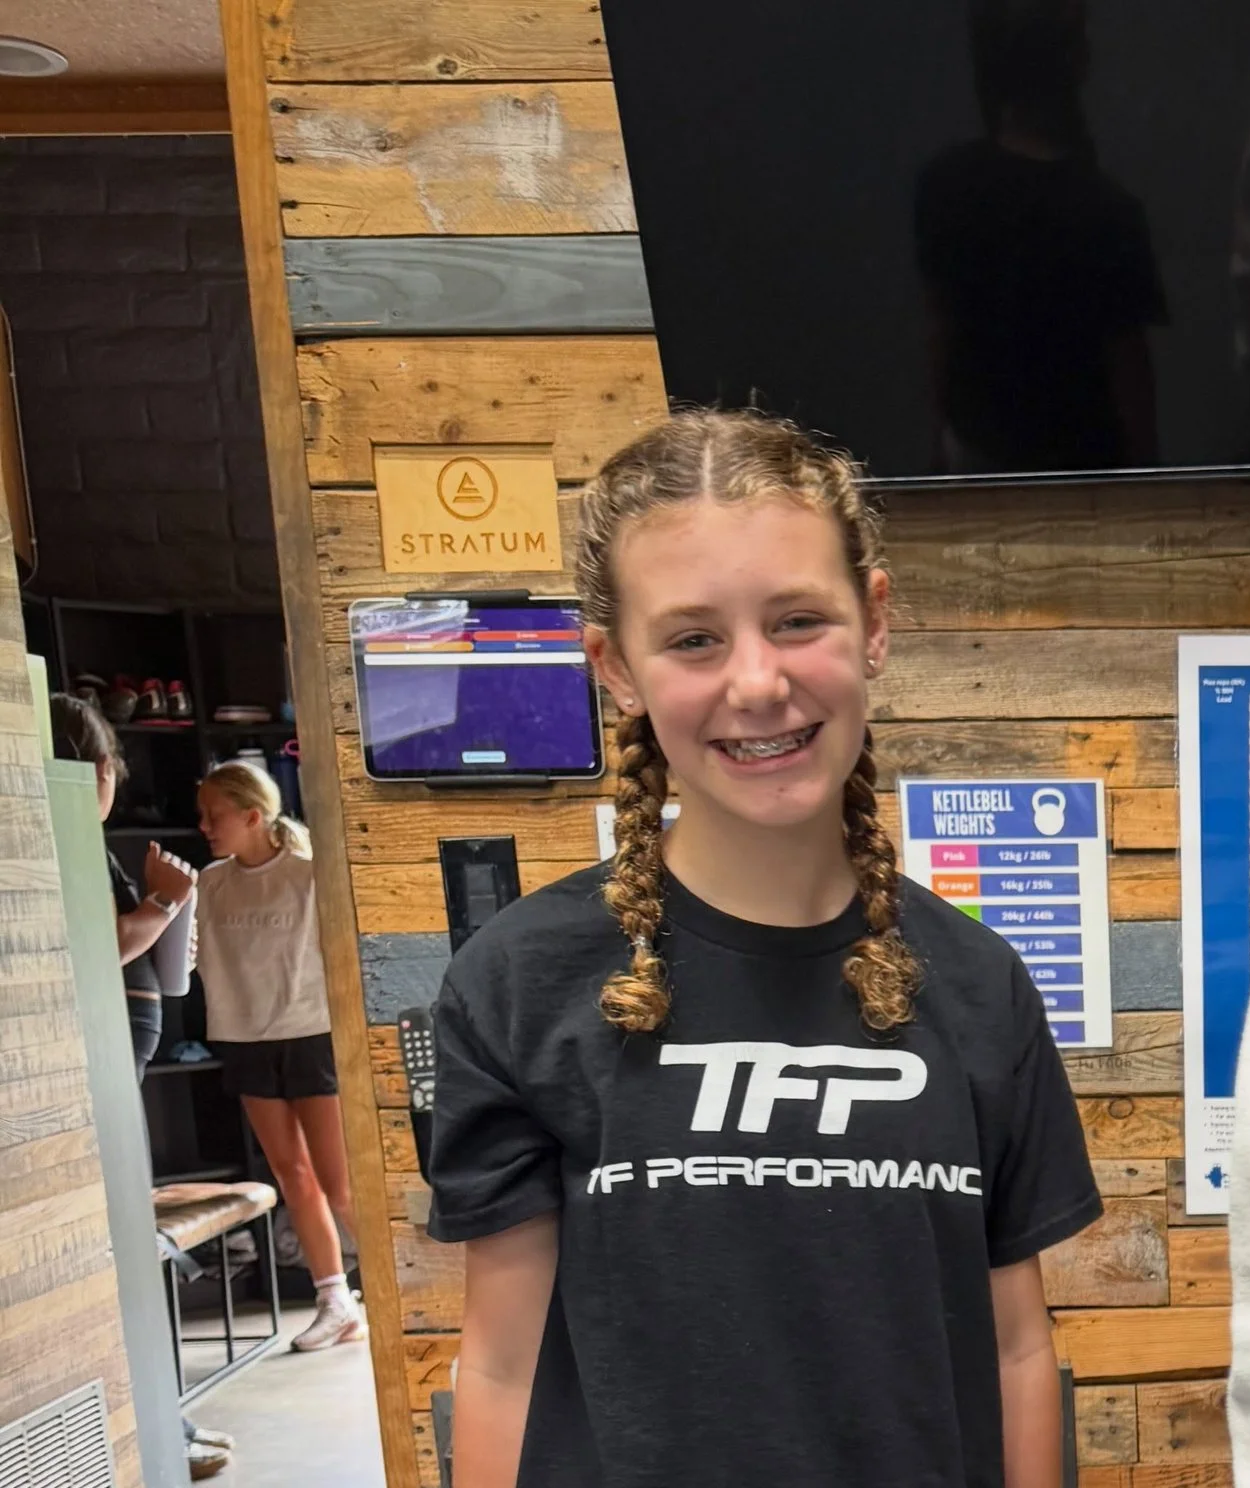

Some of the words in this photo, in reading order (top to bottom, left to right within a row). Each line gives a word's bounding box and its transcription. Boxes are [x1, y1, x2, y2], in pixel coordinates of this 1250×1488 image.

[401, 532, 546, 555] STRATUM
[933, 789, 1014, 812] KETTLEBELL
[934, 813, 996, 836] WEIGHTS
[998, 851, 1022, 863] 12kg
[937, 881, 975, 893] Orange
[1000, 880, 1025, 892] 16kg
[659, 1041, 928, 1135] TFP
